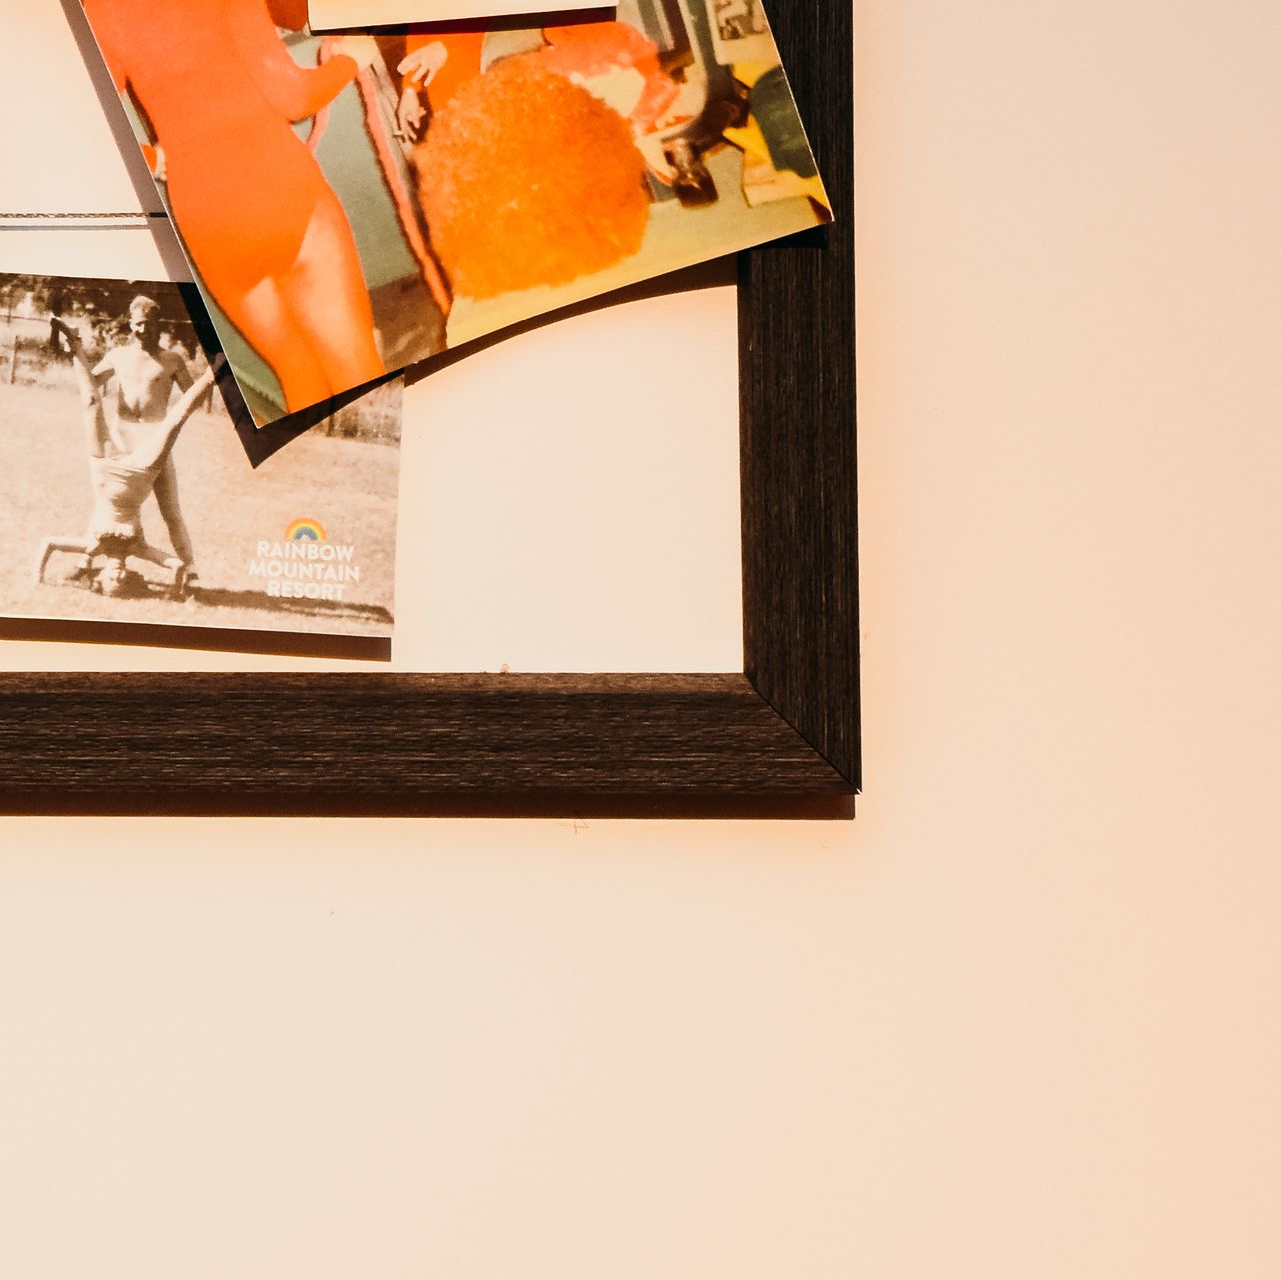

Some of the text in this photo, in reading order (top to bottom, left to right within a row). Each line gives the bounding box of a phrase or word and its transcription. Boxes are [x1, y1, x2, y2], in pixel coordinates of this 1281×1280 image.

[257, 540, 355, 562] RAINBOW
[248, 559, 360, 582] MOUNTAIN
[266, 581, 346, 601] RESORT
